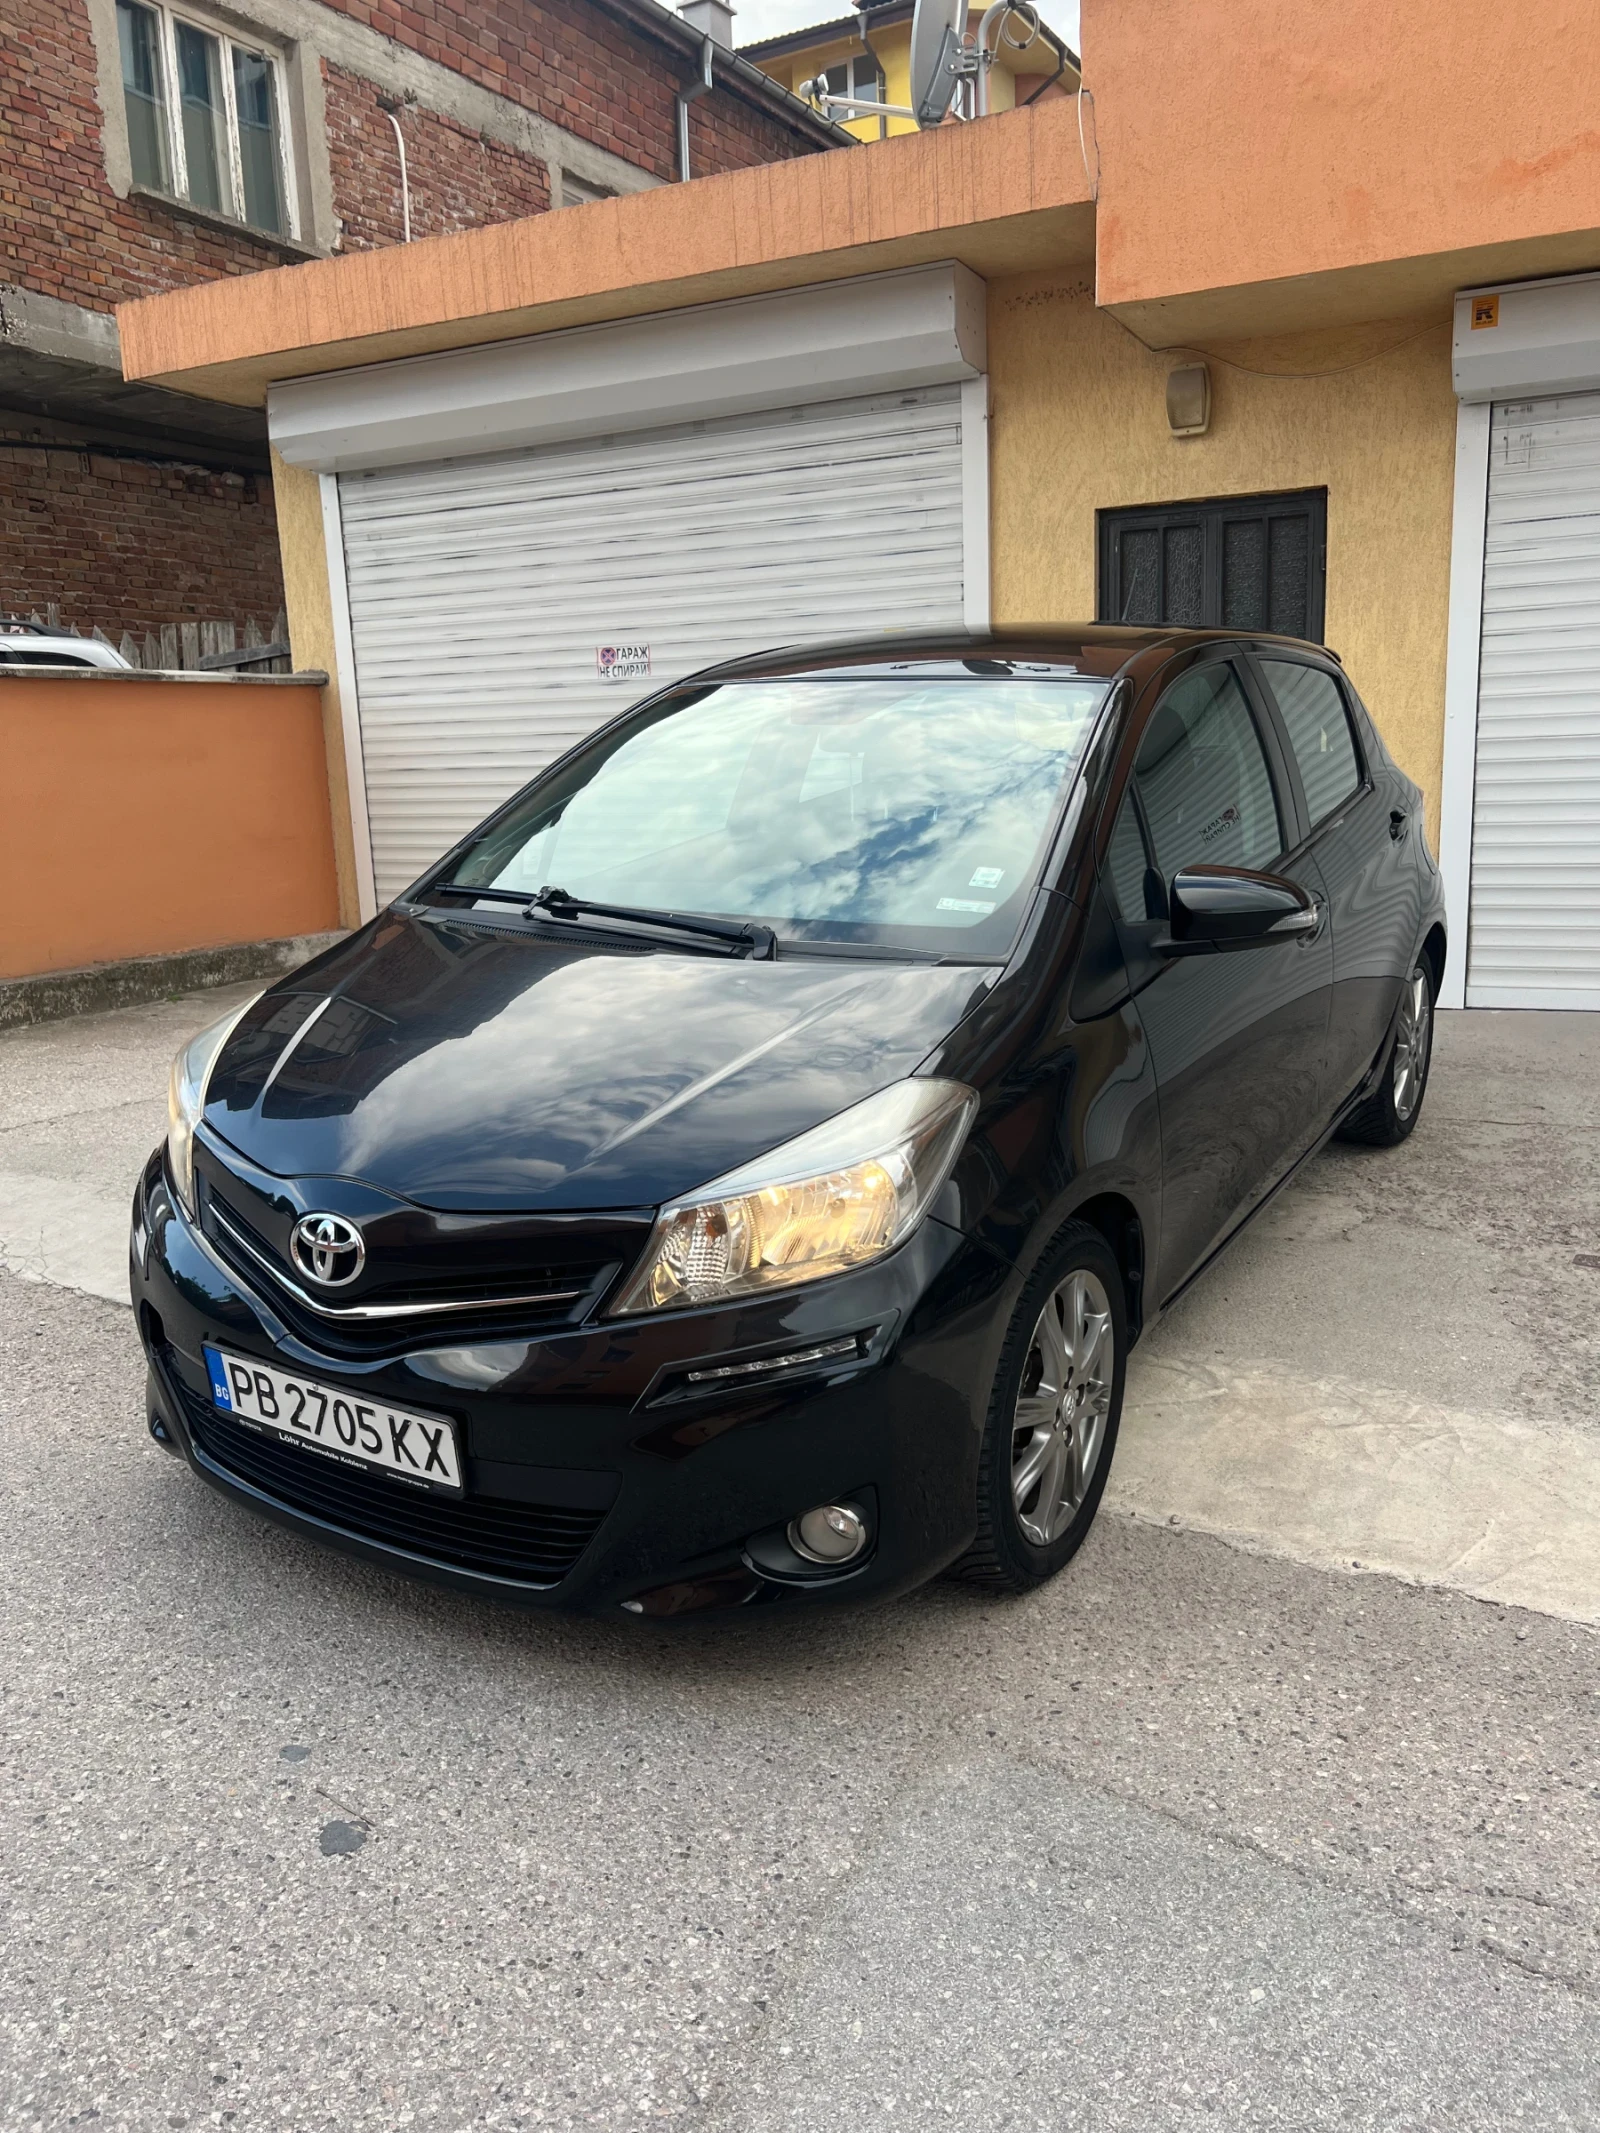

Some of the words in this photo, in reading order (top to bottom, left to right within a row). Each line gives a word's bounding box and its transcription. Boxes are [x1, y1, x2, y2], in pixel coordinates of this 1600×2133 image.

[616, 647, 648, 660] ГАРАЖ
[599, 666, 610, 677] НЕ
[215, 1383, 229, 1400] BG
[279, 1431, 299, 1446] Löhr
[301, 1442, 340, 1460] Automobile
